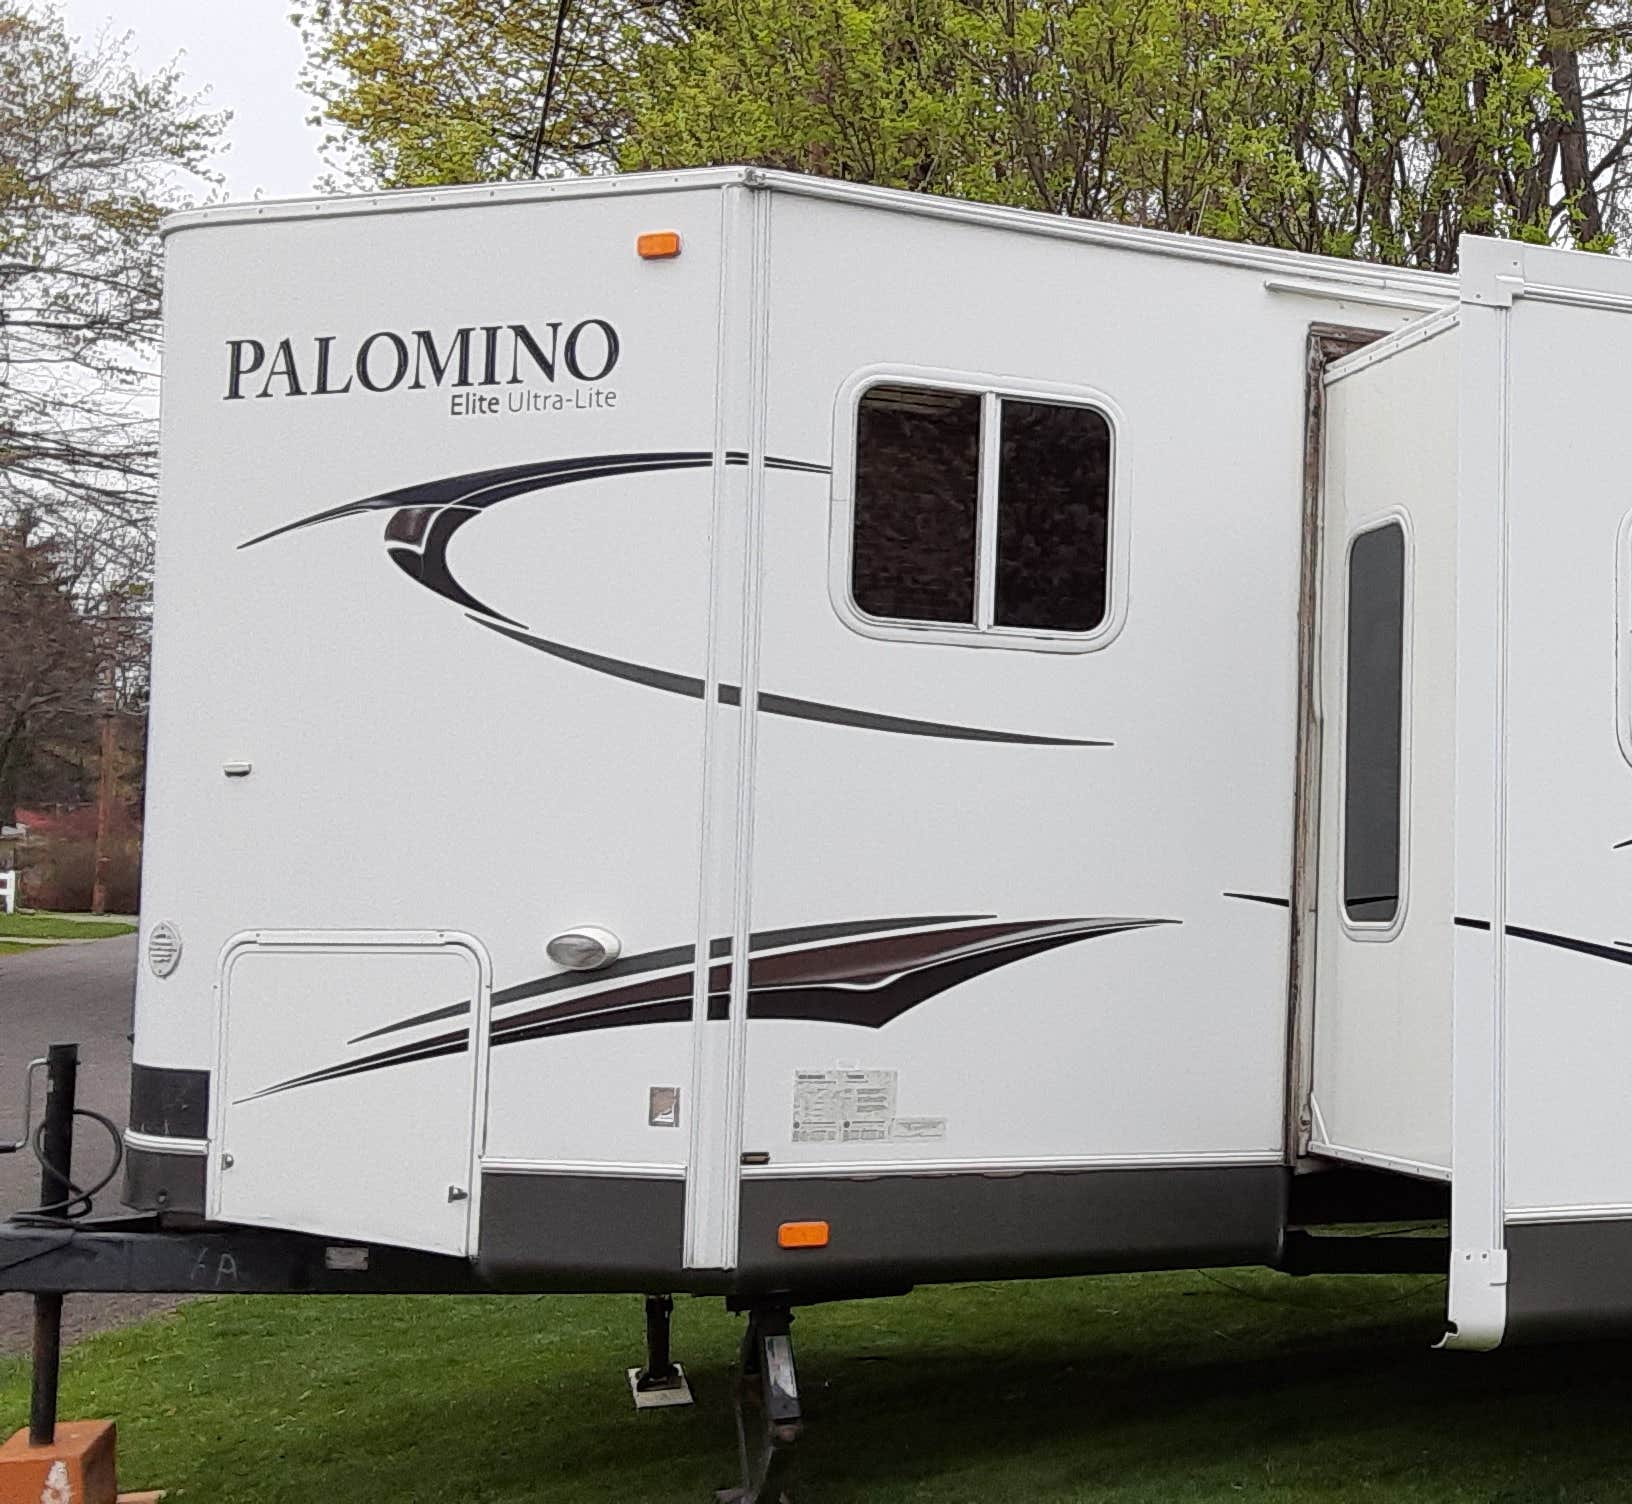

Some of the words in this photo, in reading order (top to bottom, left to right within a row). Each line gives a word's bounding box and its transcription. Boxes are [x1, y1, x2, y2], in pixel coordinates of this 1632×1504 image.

[222, 318, 620, 401] PALOMINO
[450, 391, 501, 416] Elite
[507, 386, 618, 413] Ultra-Lite
